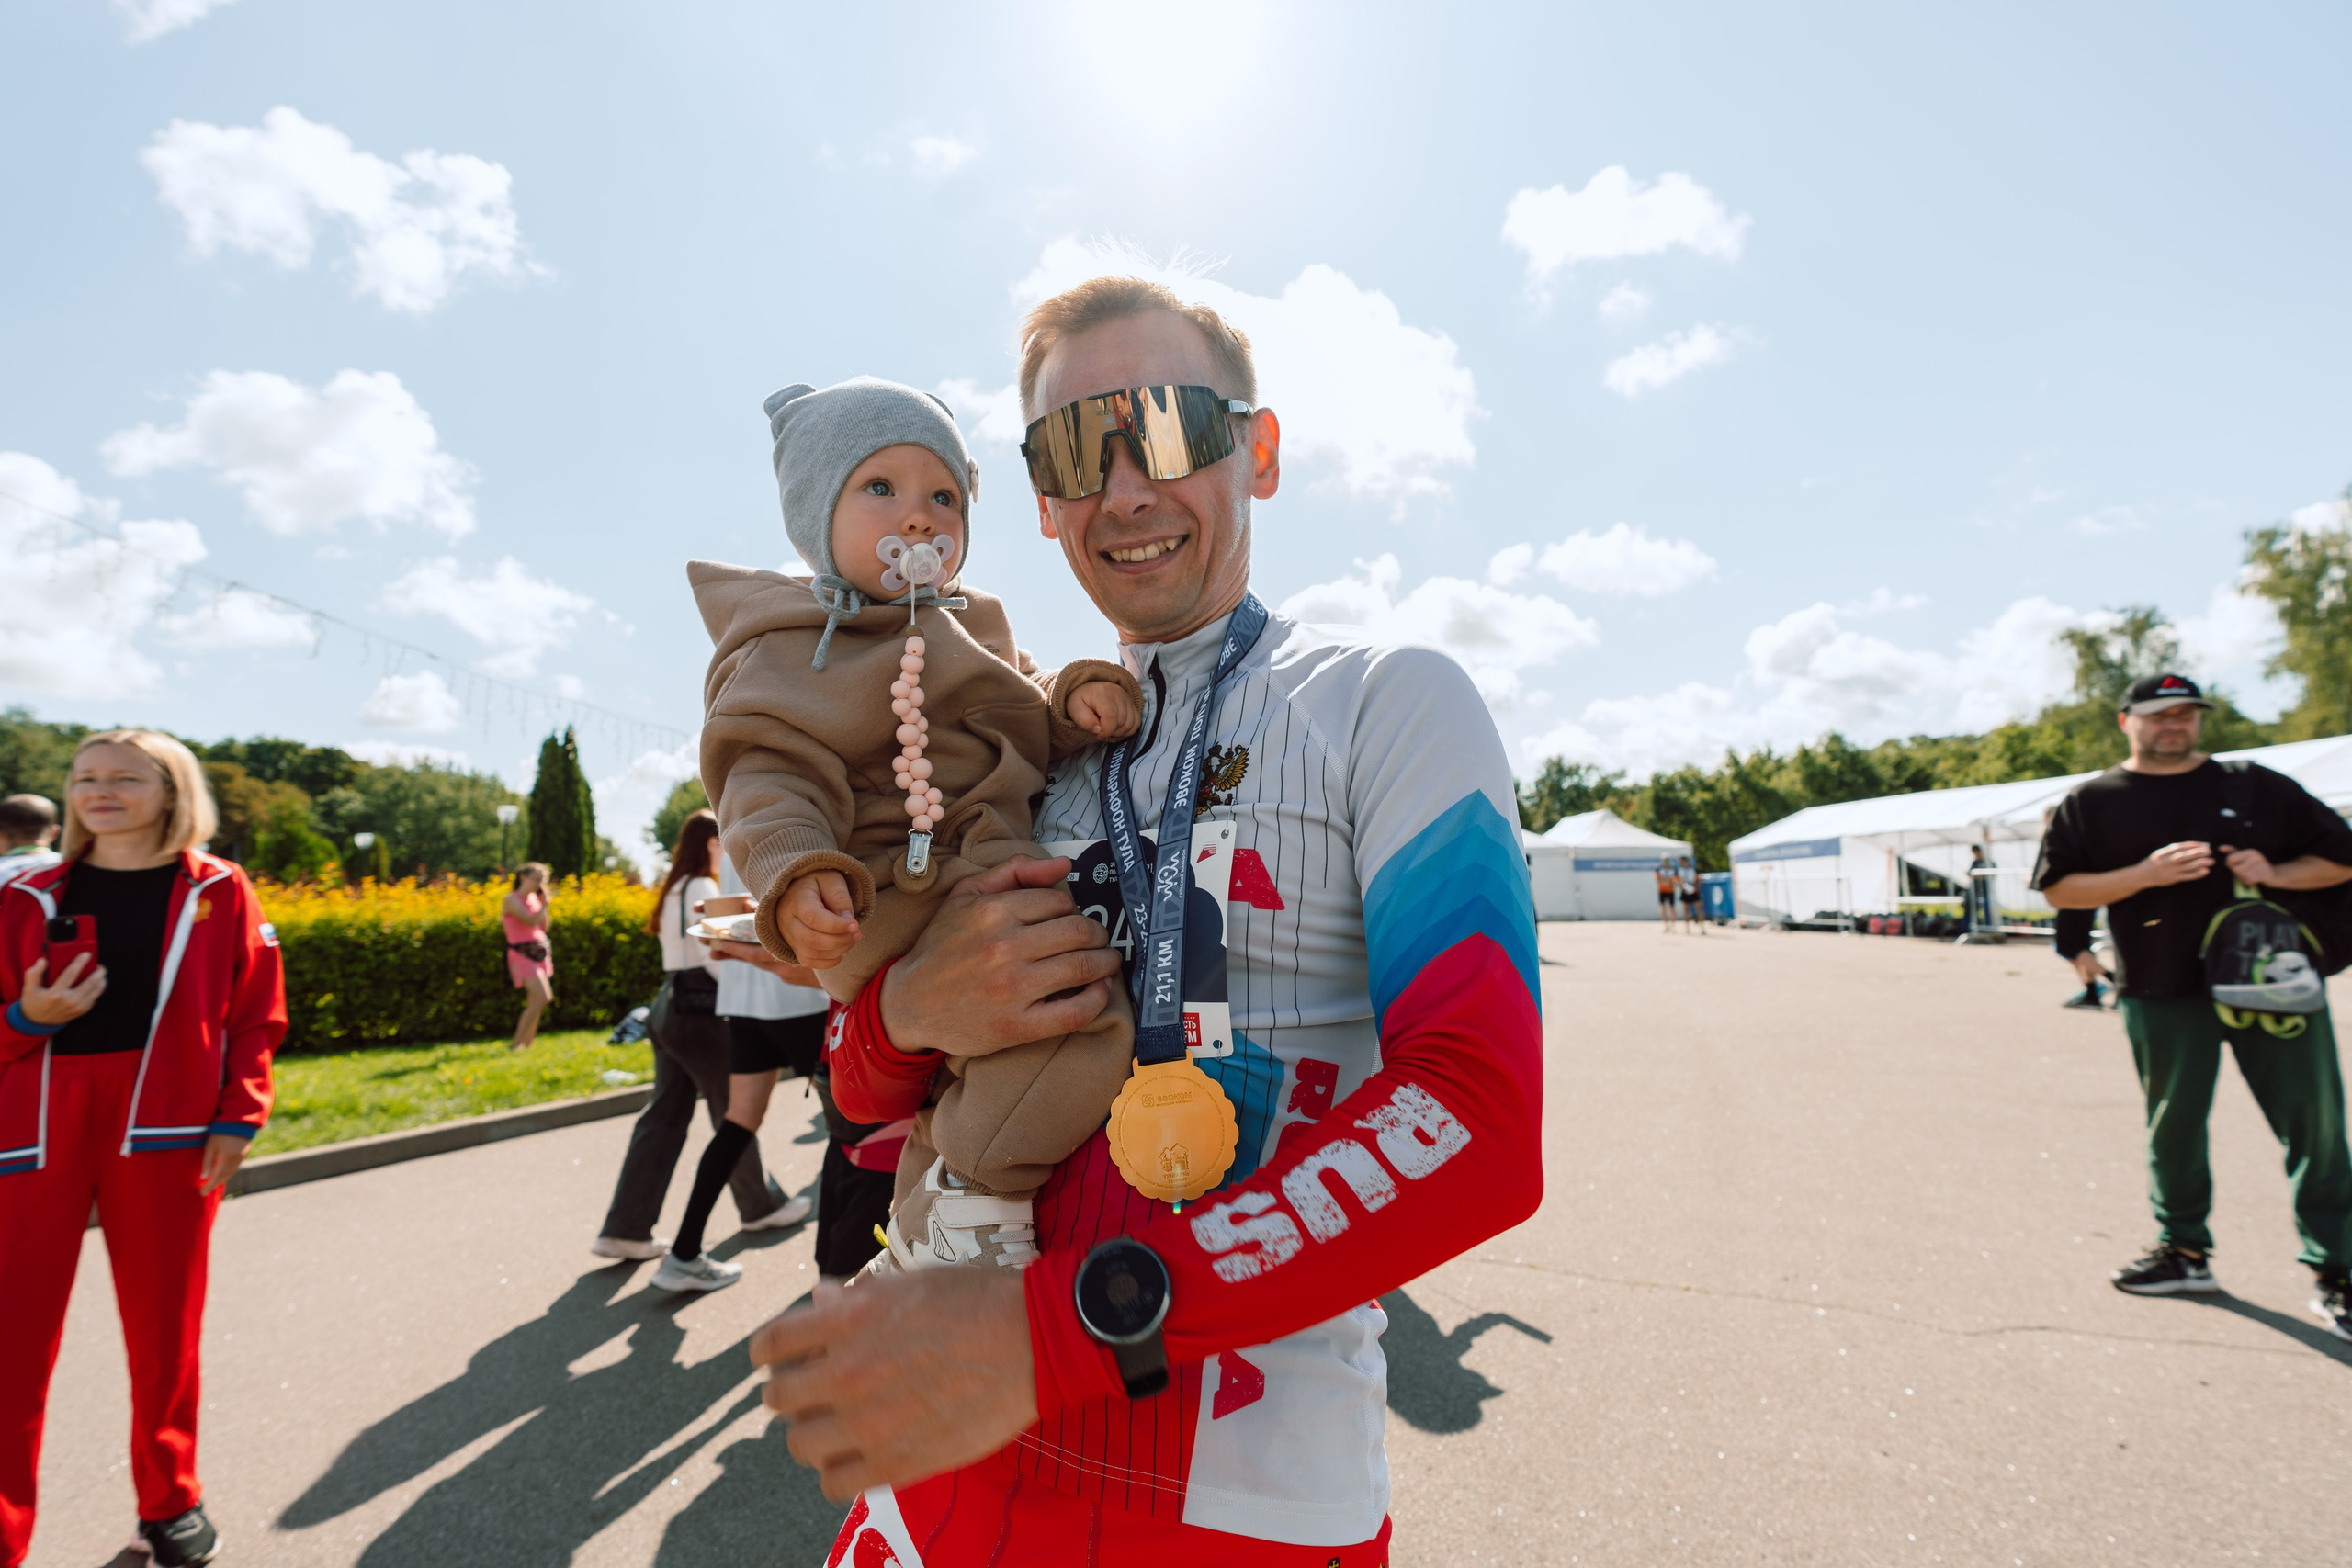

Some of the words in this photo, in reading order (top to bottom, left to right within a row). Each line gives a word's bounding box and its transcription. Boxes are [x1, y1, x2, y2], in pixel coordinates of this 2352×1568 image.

[1218, 637, 1237, 670] ЭВО
[1174, 744, 1198, 809] ЭВОКОМ
[1117, 830, 1135, 873] ТУЛА
[1158, 939, 1174, 968] КМ
[1155, 972, 1175, 1004] 21,1
[1190, 1082, 1472, 1284] RUS
